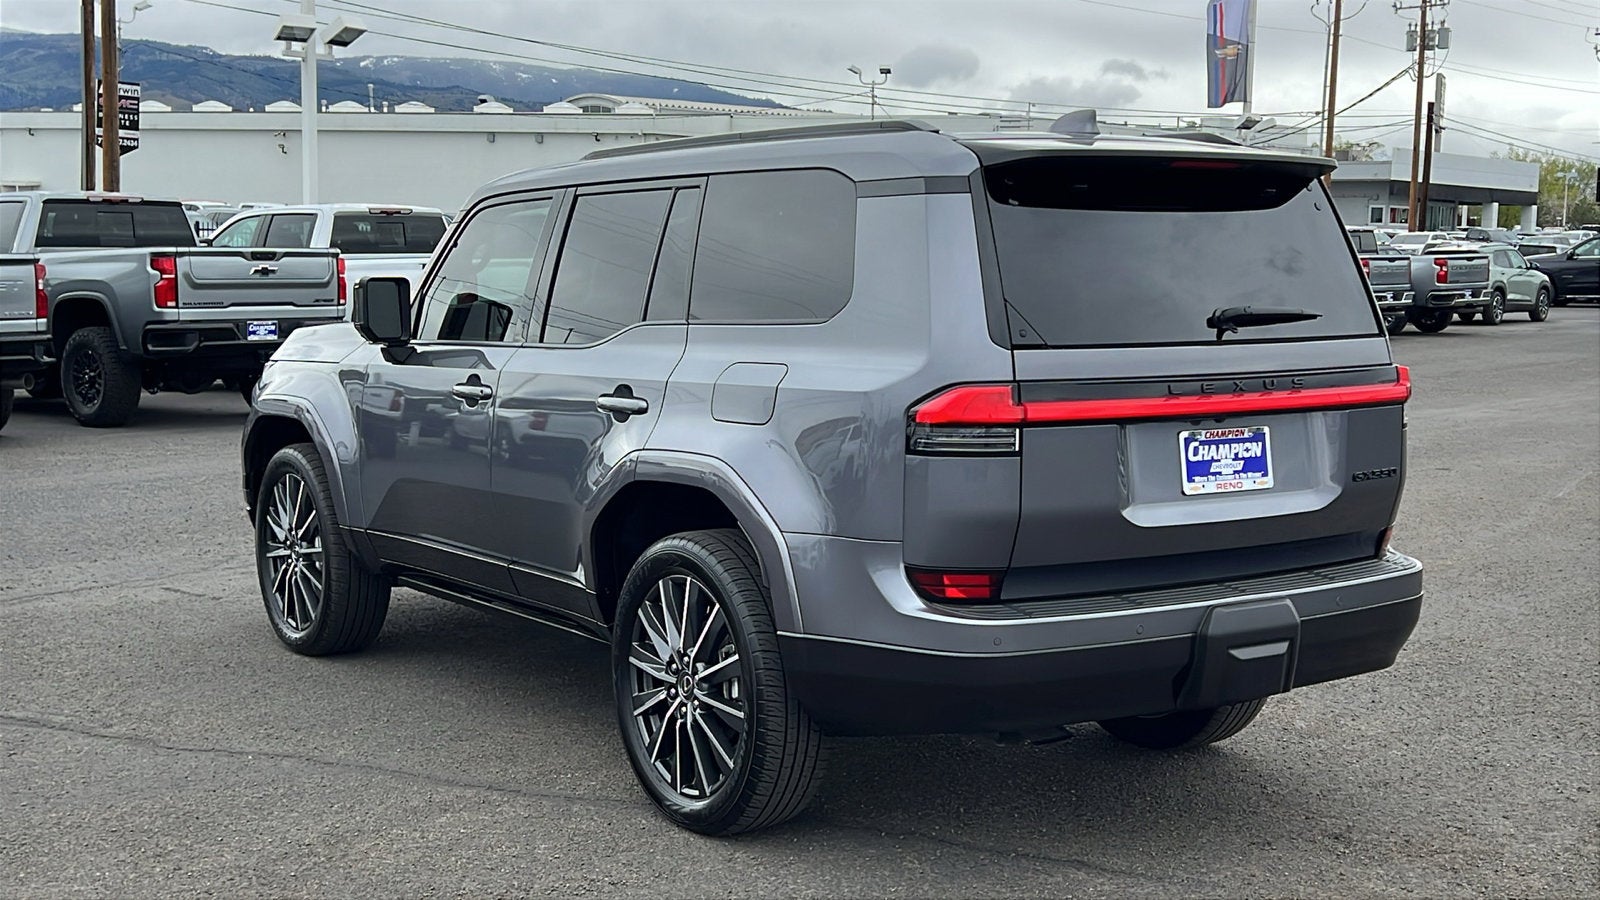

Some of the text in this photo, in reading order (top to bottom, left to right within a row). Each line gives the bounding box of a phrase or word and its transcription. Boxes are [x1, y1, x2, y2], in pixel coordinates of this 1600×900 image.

[118, 88, 139, 96] rwin
[1167, 377, 1305, 396] LEXUS
[1204, 428, 1246, 440] CHAMPION
[1187, 440, 1263, 462] CHAMPION
[1212, 461, 1242, 471] CHEVROLET
[1216, 482, 1244, 491] RENO
